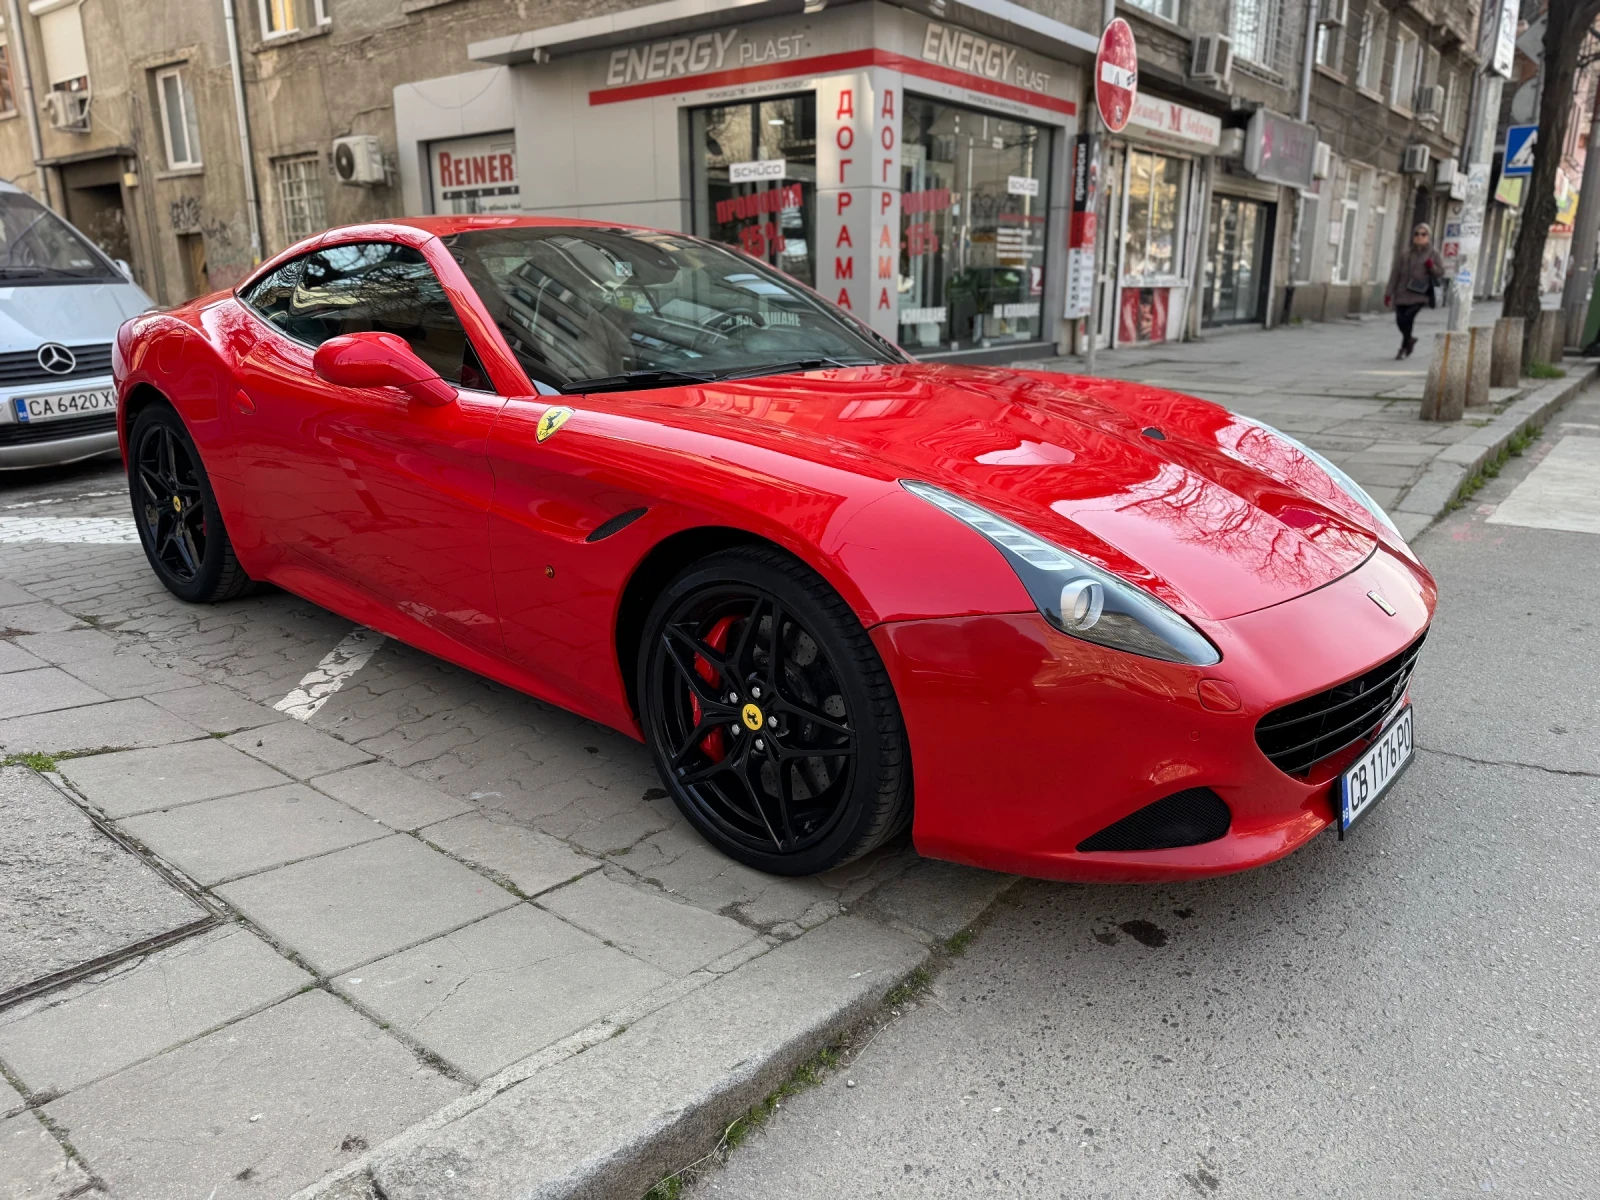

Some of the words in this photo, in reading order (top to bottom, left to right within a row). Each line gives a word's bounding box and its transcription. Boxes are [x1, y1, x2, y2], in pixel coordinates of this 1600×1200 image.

[606, 29, 738, 86] ENERGY
[739, 34, 804, 64] PLAST
[922, 21, 1017, 81] ENERGY
[1016, 66, 1050, 92] PLAST
[438, 151, 514, 188] REINER
[733, 163, 782, 178] SCHÜCO
[716, 183, 803, 224] ПРОМОЦИЯ
[835, 89, 854, 311] ДОГРАМА
[878, 89, 894, 310] ДОГРАМА
[29, 399, 55, 416] CA
[57, 393, 99, 413] 6420
